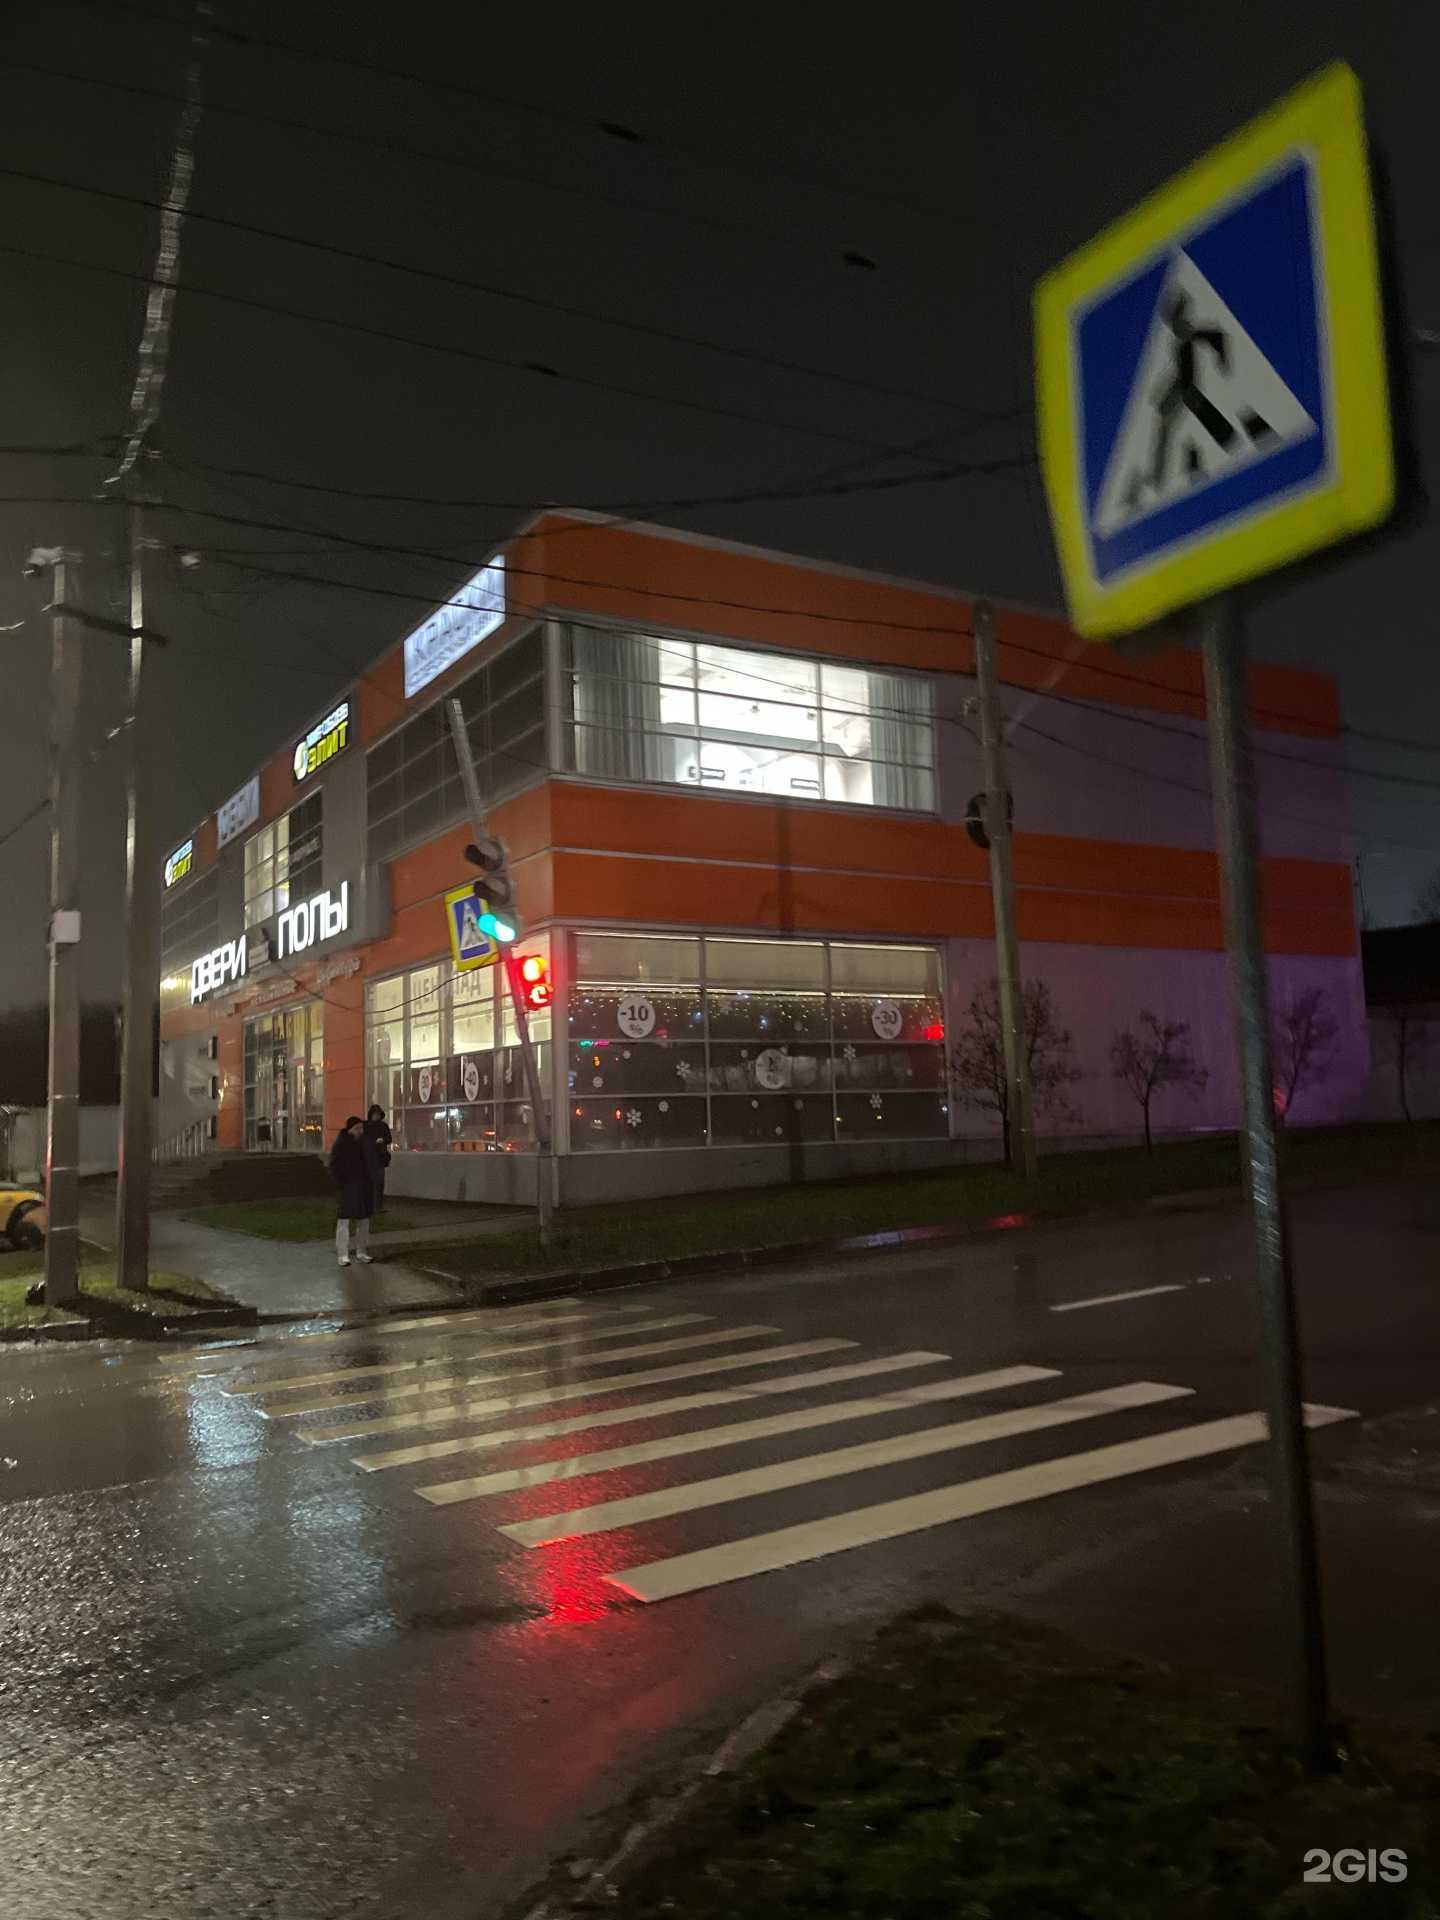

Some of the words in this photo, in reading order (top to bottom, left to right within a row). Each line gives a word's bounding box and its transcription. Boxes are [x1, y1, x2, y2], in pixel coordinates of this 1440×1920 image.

[190, 934, 247, 1006] ДВЕРИ
[278, 879, 348, 960] ПОЛЫ
[620, 1004, 648, 1021] -10
[874, 1010, 897, 1025] -30
